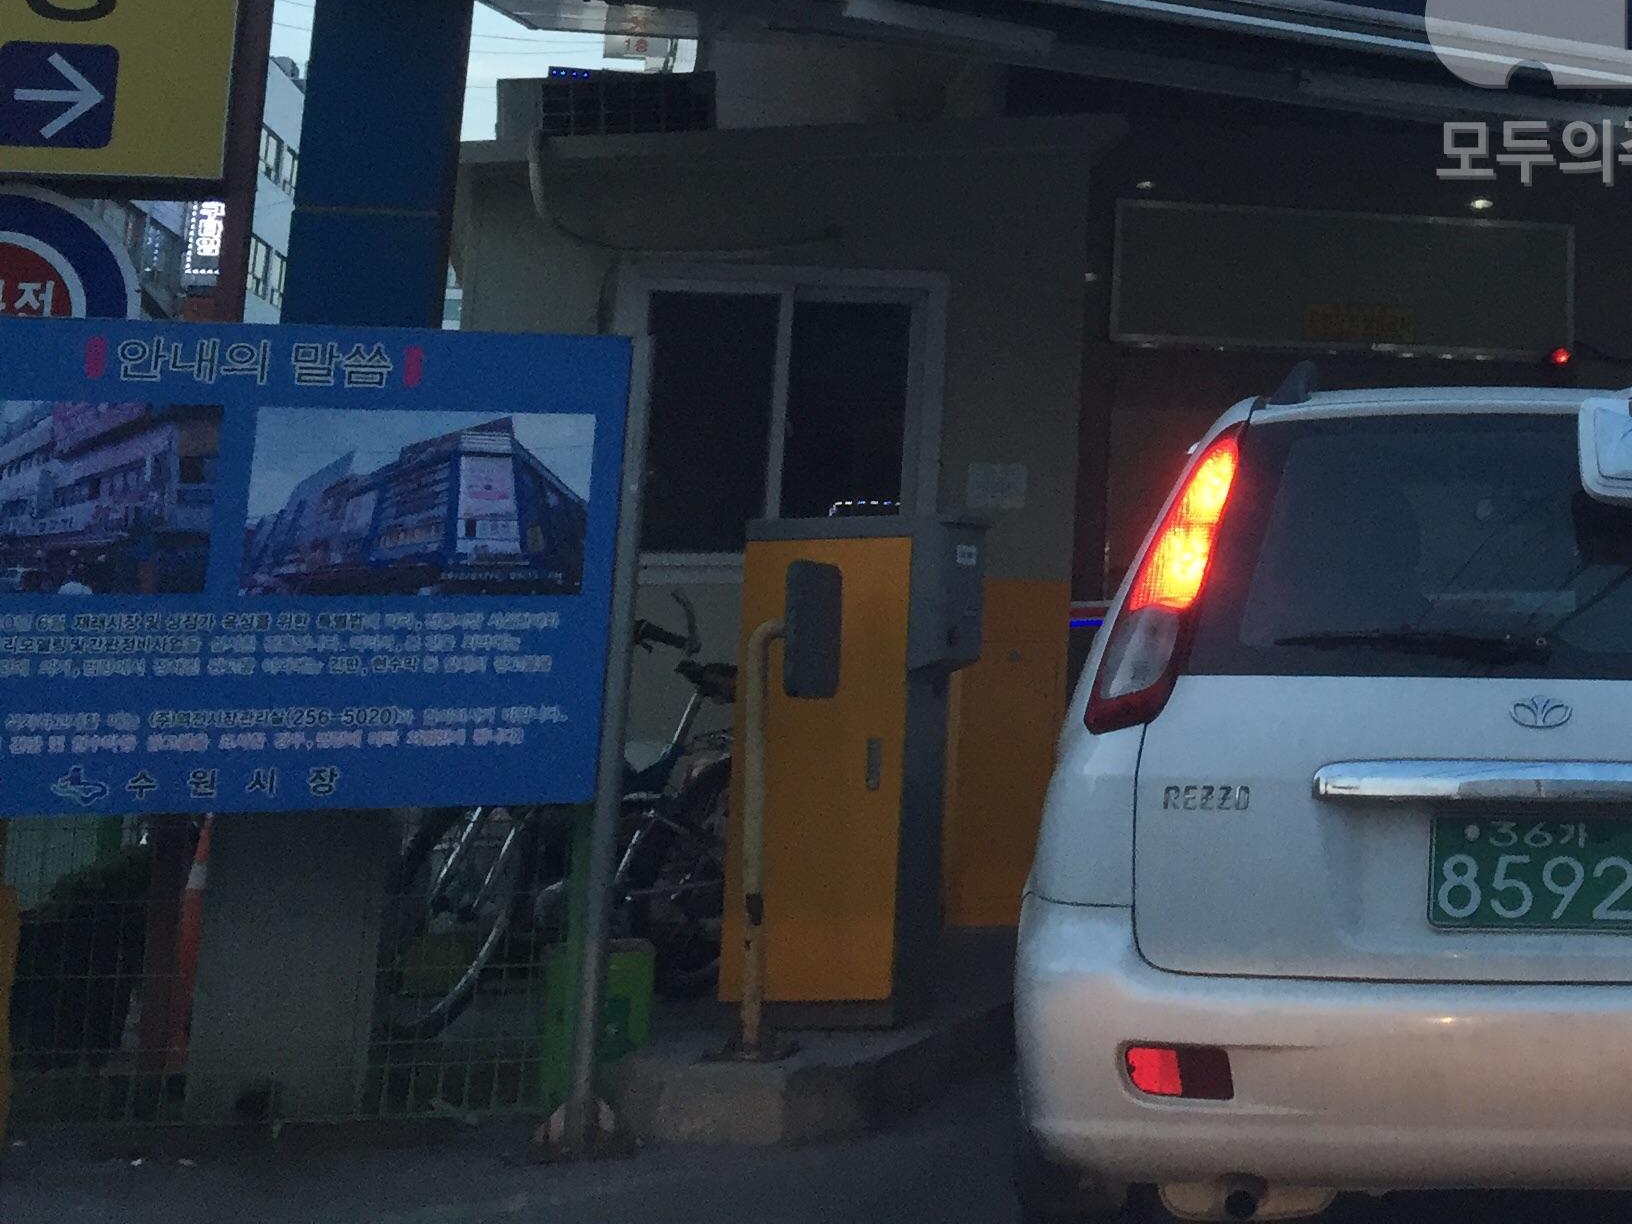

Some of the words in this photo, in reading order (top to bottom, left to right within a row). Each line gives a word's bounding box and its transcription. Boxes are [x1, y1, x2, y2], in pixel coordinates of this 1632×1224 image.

[117, 336, 270, 384] 안내의
[290, 340, 393, 389] 말씀
[1163, 784, 1251, 812] REZZO
[1488, 819, 1588, 850] 36가
